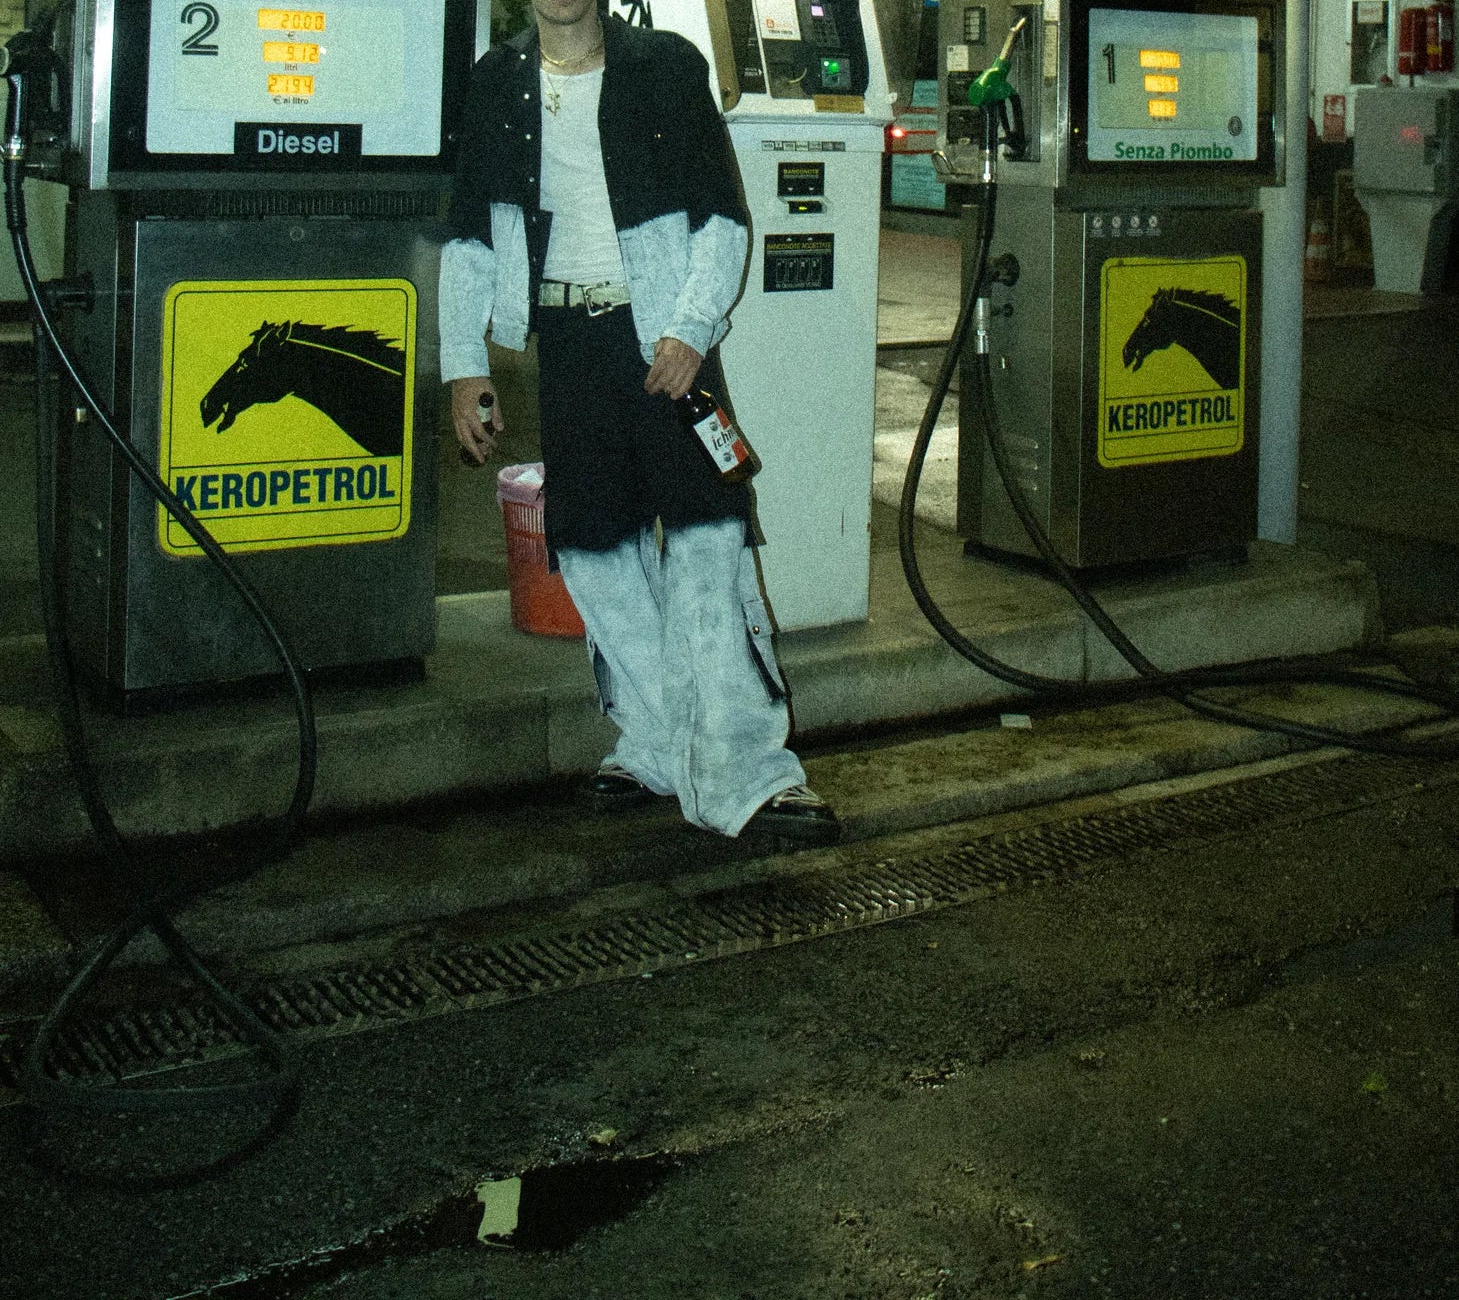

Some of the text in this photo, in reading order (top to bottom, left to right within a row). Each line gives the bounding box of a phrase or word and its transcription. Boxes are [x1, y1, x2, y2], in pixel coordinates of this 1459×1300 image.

[180, 2, 220, 56] 2
[284, 63, 298, 72] litri
[1102, 43, 1115, 84] 1
[292, 94, 309, 105] litro
[257, 130, 340, 155] Diesel
[1114, 141, 1233, 160] Senza Piombo
[1107, 394, 1236, 432] KEROPETROL
[175, 463, 396, 511] KEROPETROL
